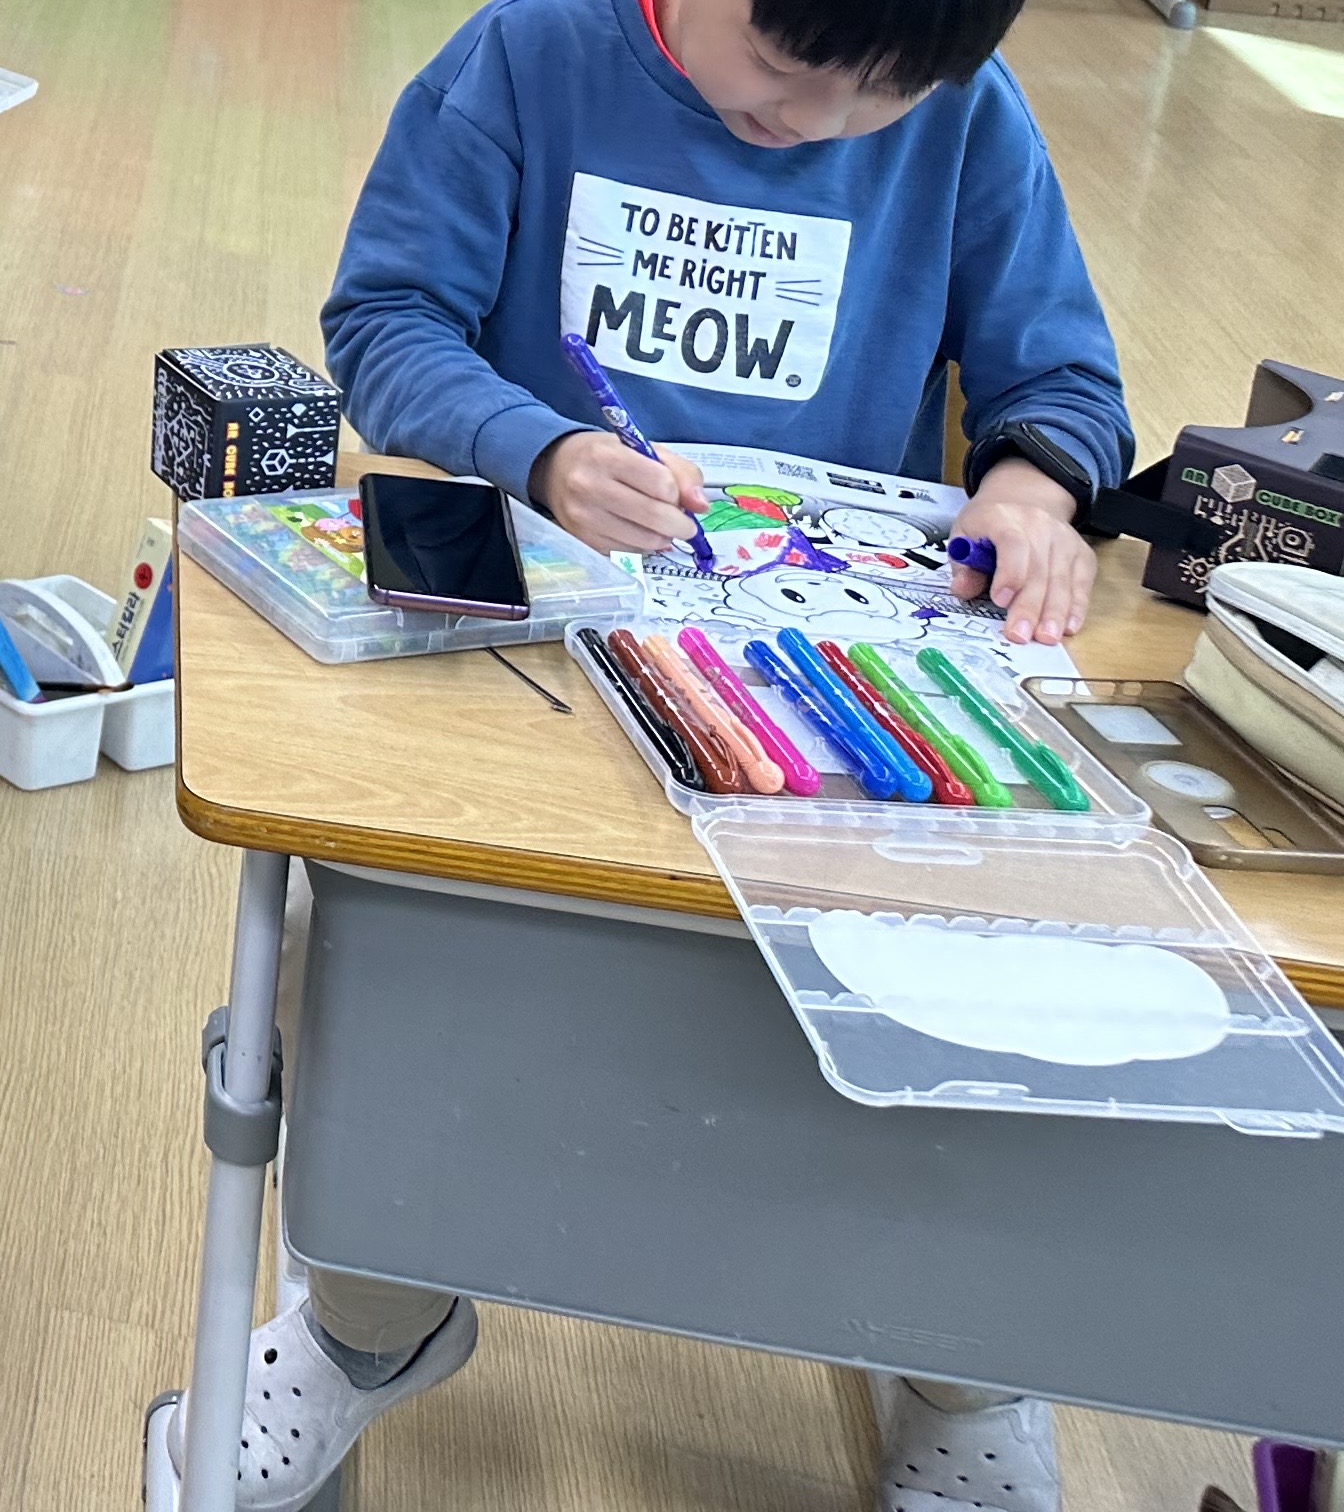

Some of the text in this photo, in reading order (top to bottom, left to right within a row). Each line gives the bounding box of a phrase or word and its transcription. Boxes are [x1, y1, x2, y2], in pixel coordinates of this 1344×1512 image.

[621, 201, 661, 237] TO
[666, 213, 699, 247] BE
[632, 249, 675, 281] ME
[1181, 467, 1344, 528] AR CUBE BOX
